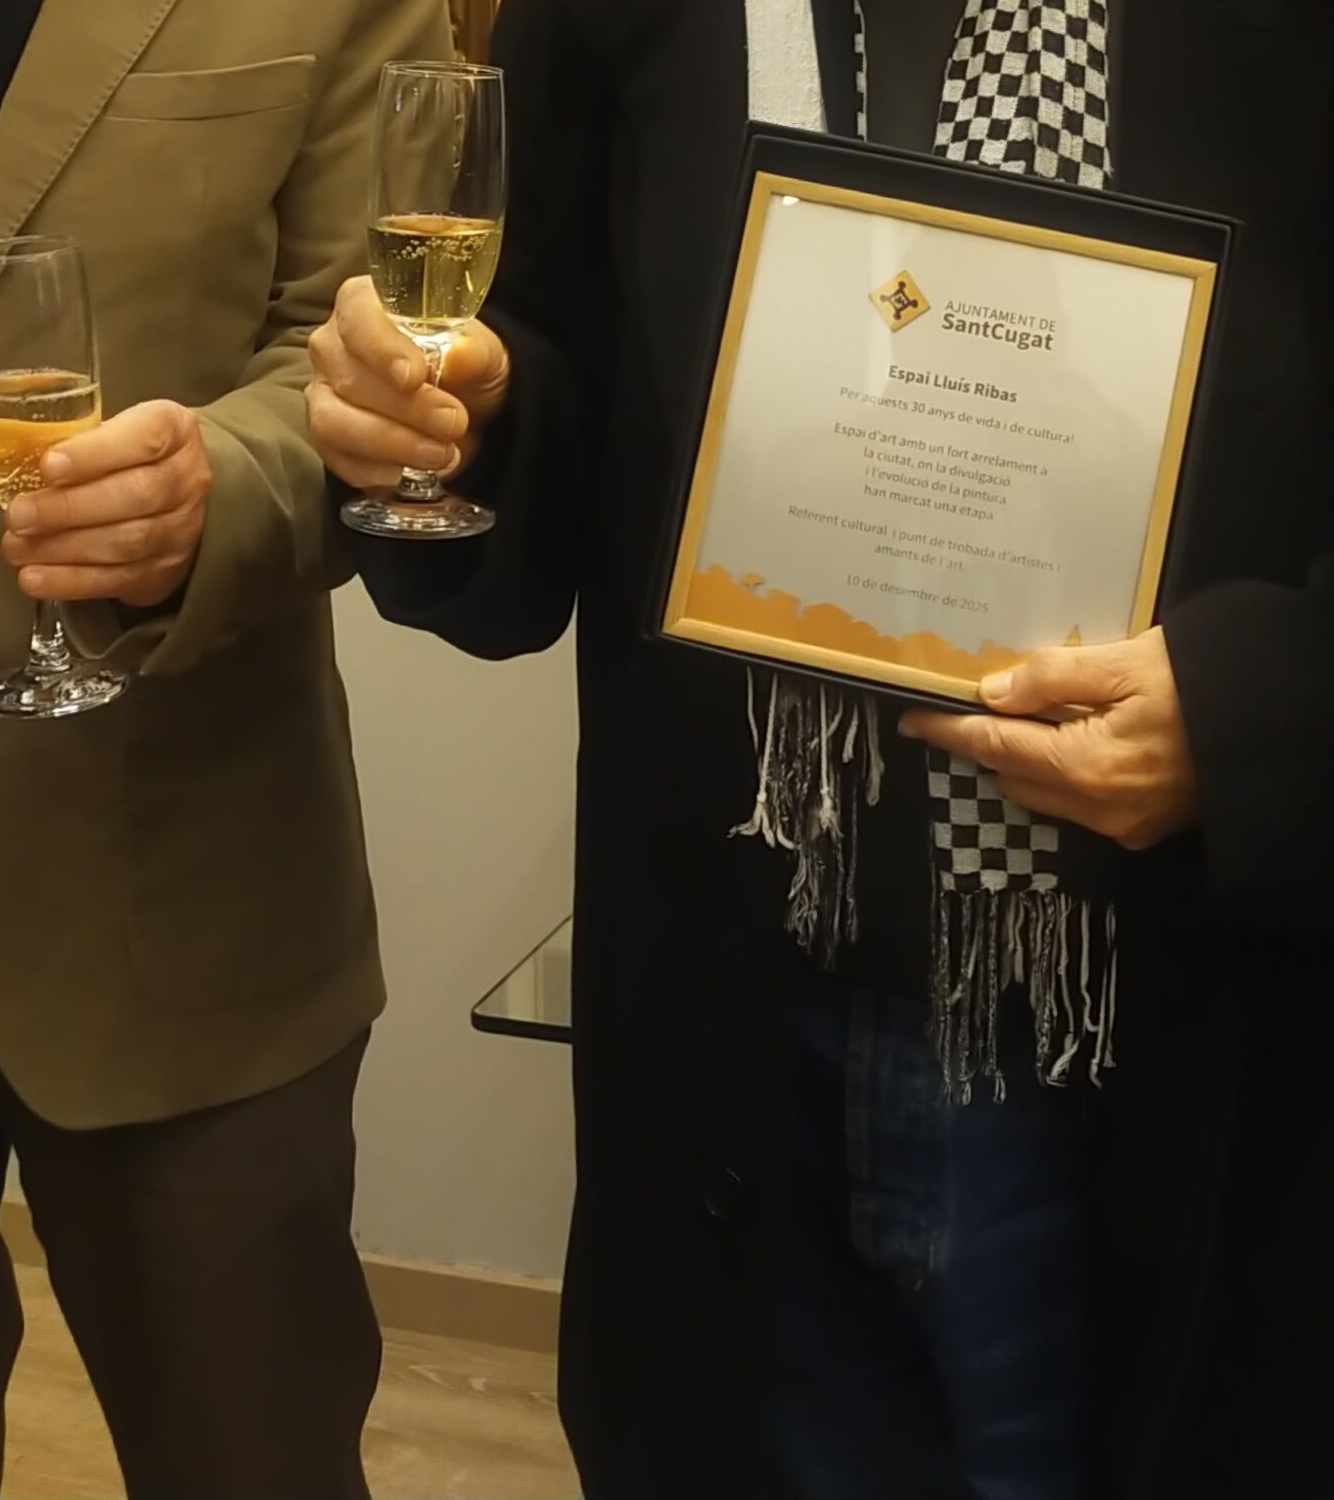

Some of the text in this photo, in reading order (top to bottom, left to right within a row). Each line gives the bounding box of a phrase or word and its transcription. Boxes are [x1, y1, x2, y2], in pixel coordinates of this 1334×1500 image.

[941, 312, 1054, 351] SantCugat
[944, 300, 1058, 332] AJUNTAMENT DE
[888, 365, 1018, 403] Espai Lluís Ribas
[839, 386, 860, 400] Per
[861, 392, 908, 411] aquests
[910, 401, 926, 414] 30
[927, 406, 955, 421] anys
[957, 411, 974, 424] de
[976, 415, 1001, 431] vida
[1009, 421, 1025, 435] de
[1027, 427, 1075, 445] cultura!
[834, 422, 1048, 476] Espai d'art amb un fort arrelament a
[863, 447, 1011, 488] la ciutat, on la divulgació
[863, 484, 887, 498] han
[889, 490, 931, 508] marcat
[934, 501, 957, 513] una
[871, 466, 929, 489] l'evolució
[931, 479, 948, 492] de
[949, 482, 960, 495] la
[962, 488, 1007, 506] pintura
[788, 505, 839, 525] Referent
[841, 518, 888, 536] cultural
[899, 530, 927, 546] punt
[929, 535, 946, 548] de
[948, 540, 996, 560] trobada
[874, 544, 919, 562] amants
[921, 552, 937, 565] de
[847, 574, 989, 614] 10 de desembre de 2025
